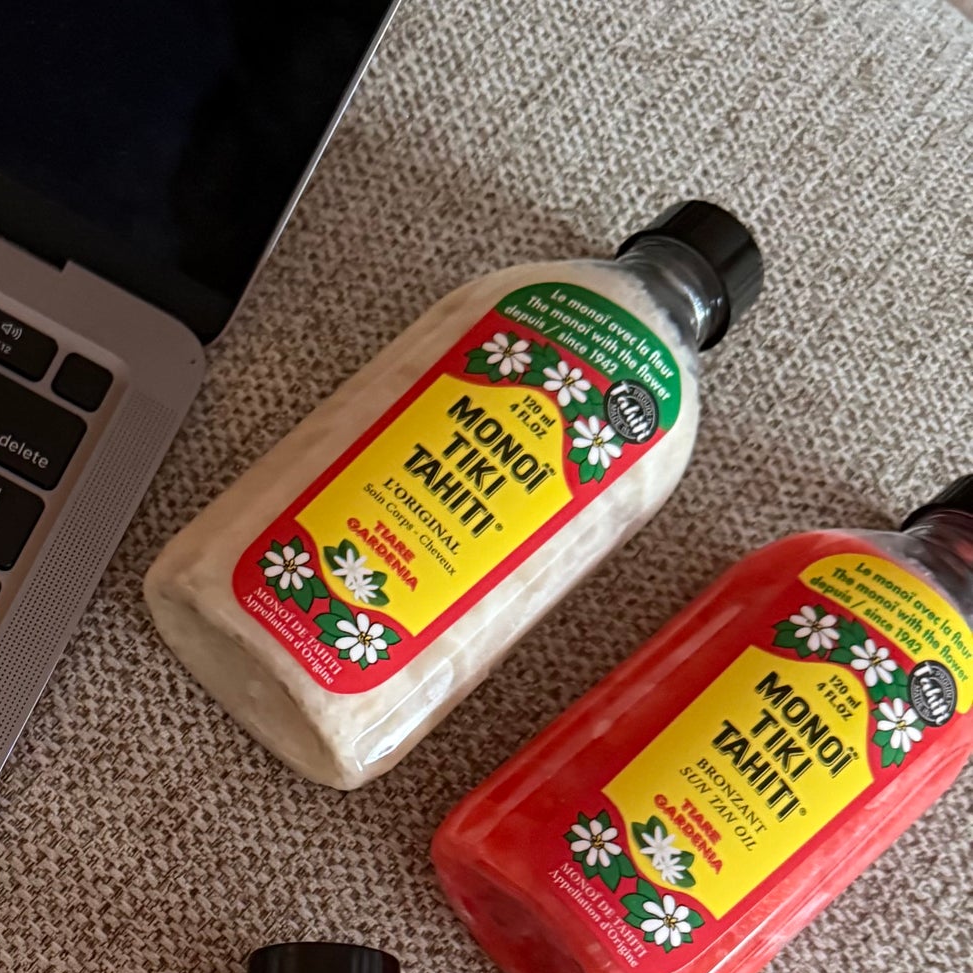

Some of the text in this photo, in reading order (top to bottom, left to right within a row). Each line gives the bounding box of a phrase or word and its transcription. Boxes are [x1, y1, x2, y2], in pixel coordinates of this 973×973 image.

[504, 304, 619, 375] depuis since 1942
[527, 296, 671, 401] The monoï with the flower
[550, 289, 675, 379] Le monoï avec la fleur
[446, 394, 556, 495] MONOÏ
[509, 403, 548, 441] 4 FL.OZ
[522, 395, 557, 428] 120 ml
[442, 431, 507, 499] TIKI
[347, 517, 419, 592] GARDENIA
[363, 482, 457, 577] Soin Corps Cheveux
[374, 520, 415, 564] TIARE
[383, 478, 461, 556] L'ORIGINAL
[243, 594, 334, 685] Appellation d'Origine
[253, 587, 342, 676] MONOÏ DE TAHITI
[810, 576, 922, 655] depuis since 1942
[832, 568, 968, 682] The monoï with the flower
[855, 562, 972, 660] Le monoï avec la fleur
[754, 670, 859, 779] MONOÏ
[816, 682, 853, 721] 4 FL.OZ
[828, 675, 862, 709] 120 ml
[750, 708, 813, 782] TIKI
[654, 794, 723, 875] GARDENIA
[679, 766, 757, 852] SUN TAN OIL
[682, 798, 722, 845] TIARE
[696, 758, 768, 833] BRONZANT
[548, 869, 640, 968] Appellation d'Origine
[559, 863, 648, 958] MONOÏ DE TAHITI
